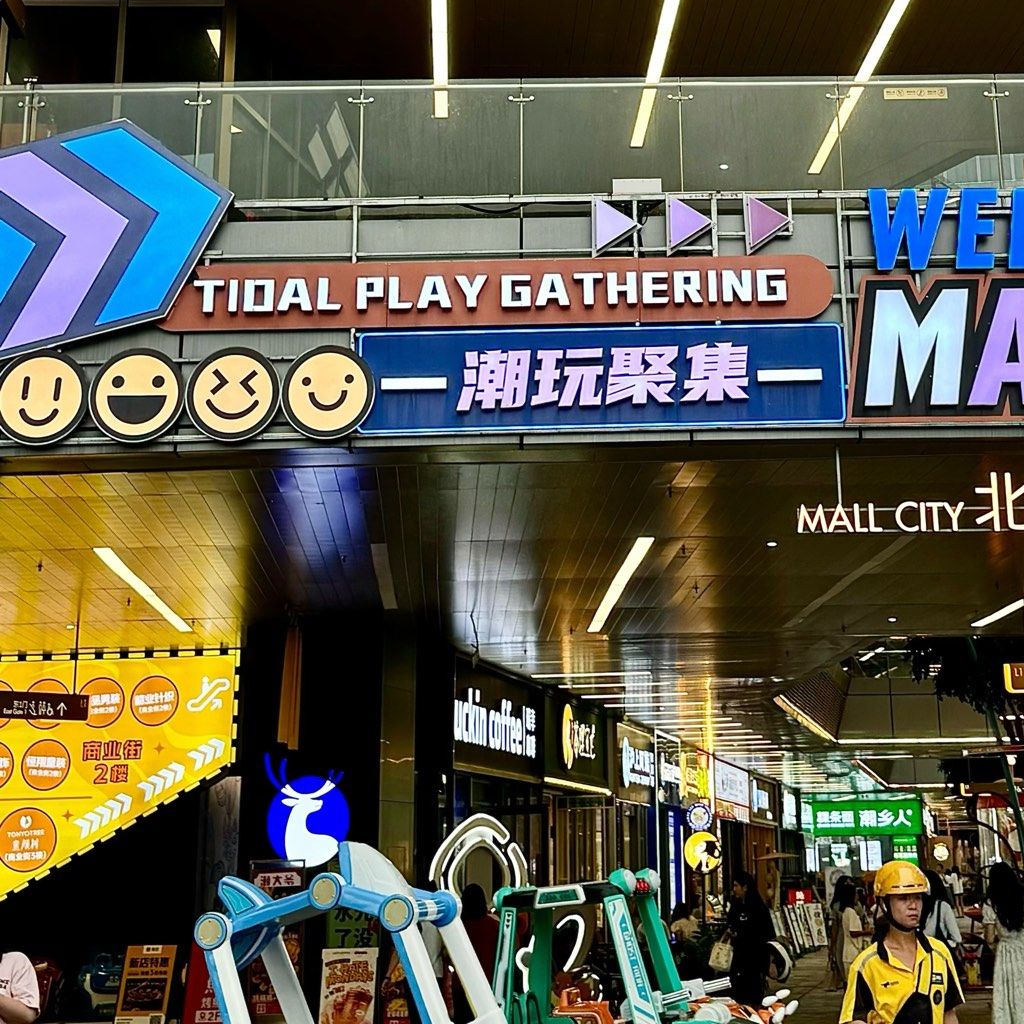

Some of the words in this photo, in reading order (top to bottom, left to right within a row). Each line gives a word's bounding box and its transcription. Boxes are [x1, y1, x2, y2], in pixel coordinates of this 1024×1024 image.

[194, 277, 341, 314] TIDAL
[356, 274, 487, 311] PLAY
[500, 268, 787, 308] GATHERING
[456, 342, 751, 412] 潮玩聚集
[797, 503, 882, 533] MALL
[895, 501, 964, 532] CITY
[454, 687, 488, 747] uckin
[489, 698, 523, 756] coffee
[82, 740, 143, 761] 商业街
[93, 764, 129, 784] 2楼
